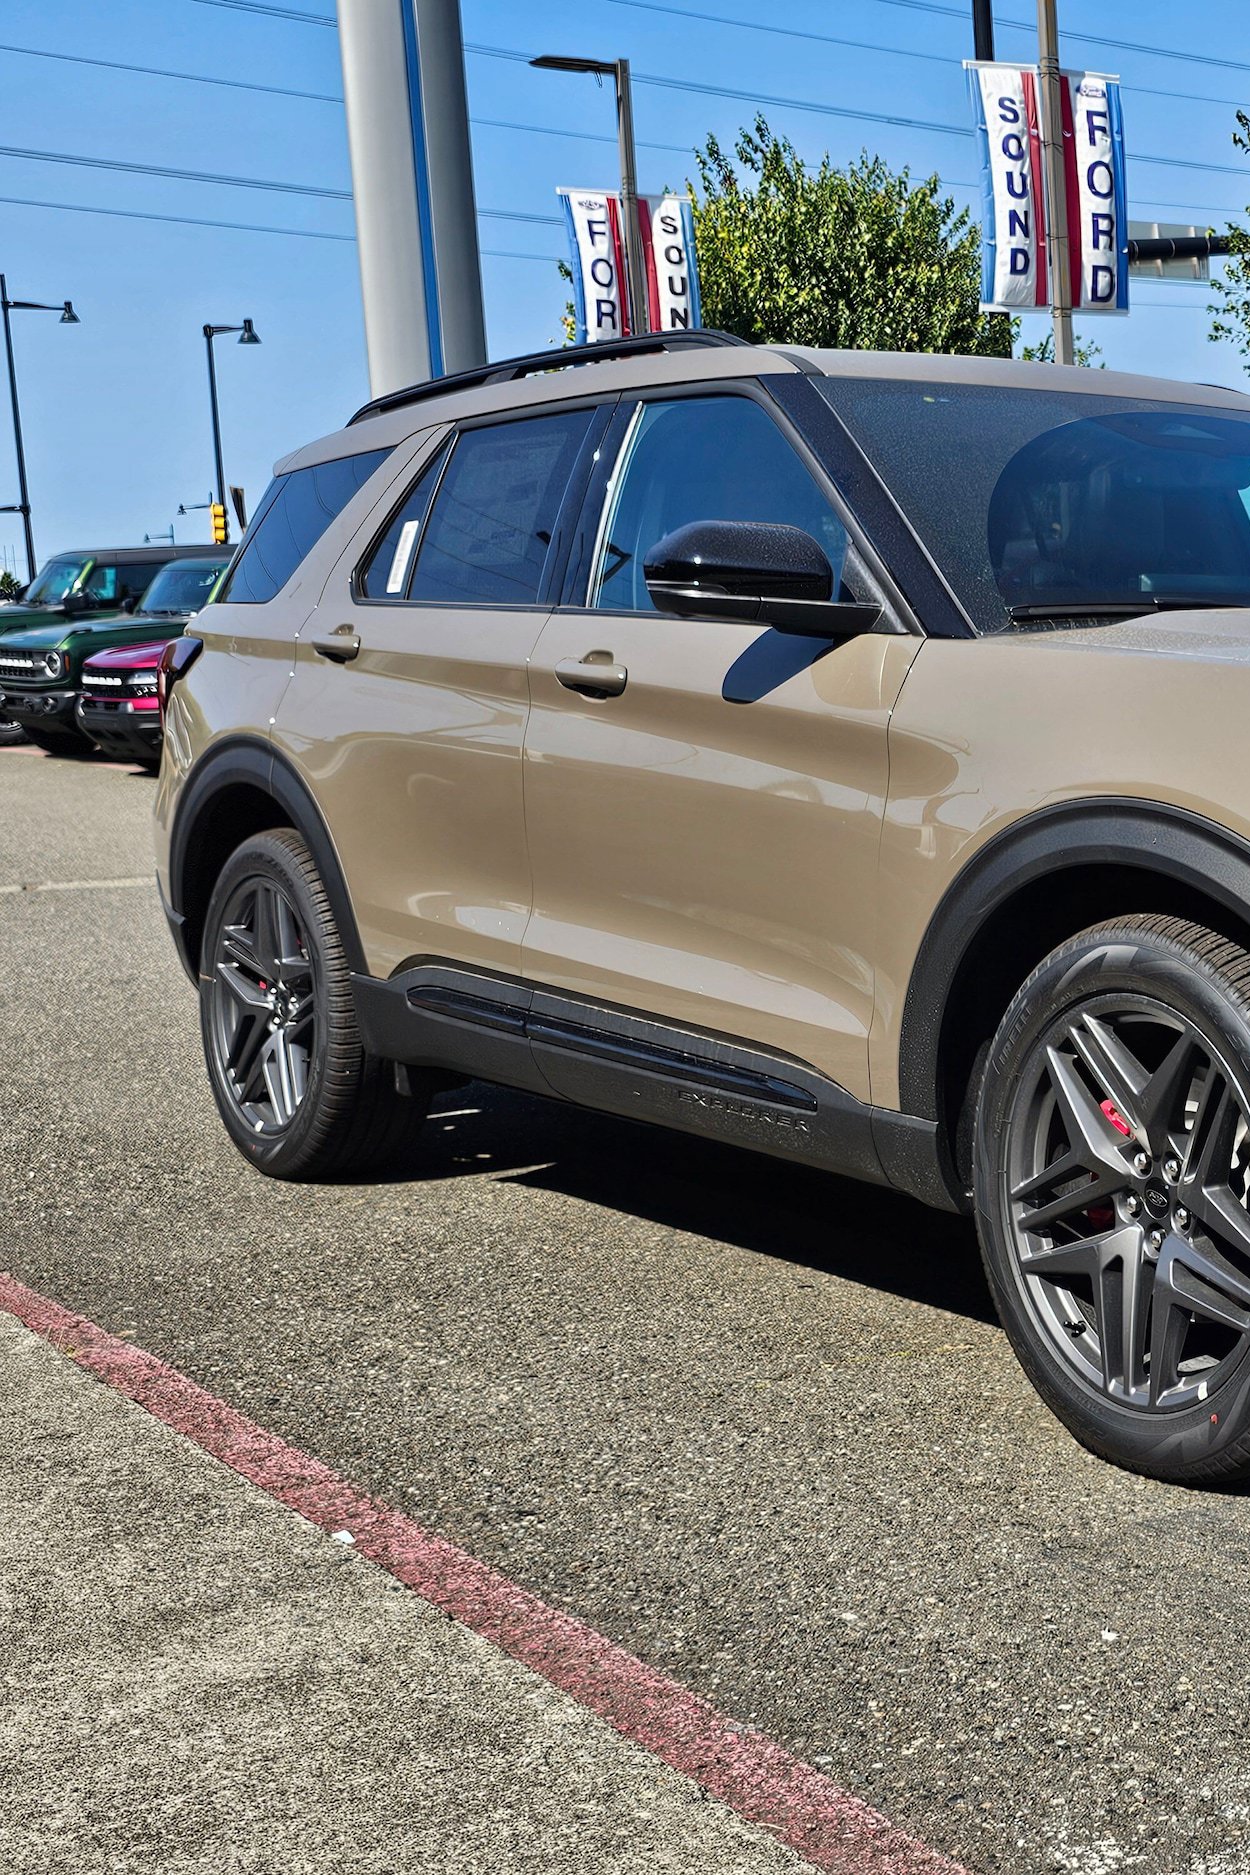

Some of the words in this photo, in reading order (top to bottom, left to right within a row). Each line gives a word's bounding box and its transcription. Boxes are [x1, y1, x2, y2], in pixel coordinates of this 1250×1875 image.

[998, 97, 1030, 277] SOUND
[1086, 110, 1115, 304] FORD
[587, 219, 618, 342] FOR
[660, 215, 689, 330] SOUN
[678, 1090, 810, 1133] EXPLORER
